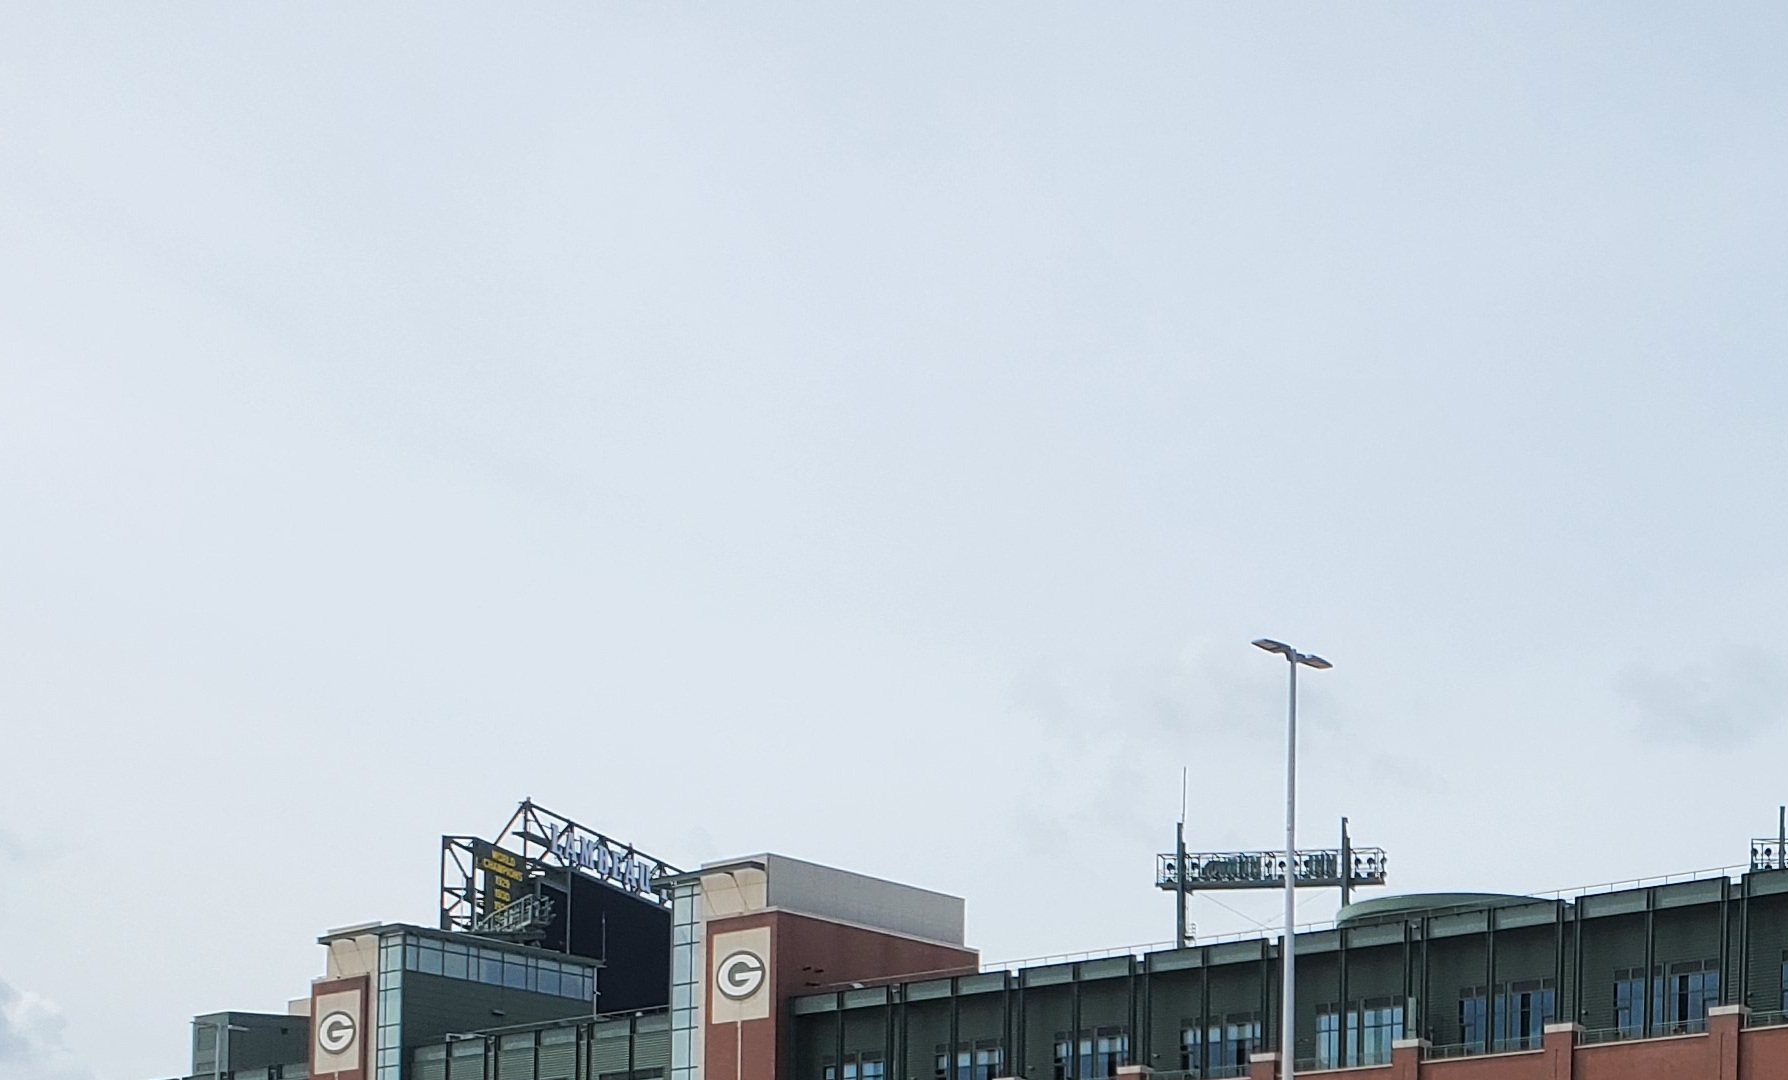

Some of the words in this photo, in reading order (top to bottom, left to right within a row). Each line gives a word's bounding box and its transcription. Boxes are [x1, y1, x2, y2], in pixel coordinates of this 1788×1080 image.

[550, 822, 652, 895] LAMBEAU
[716, 950, 766, 1000] G
[318, 1011, 357, 1054] G
